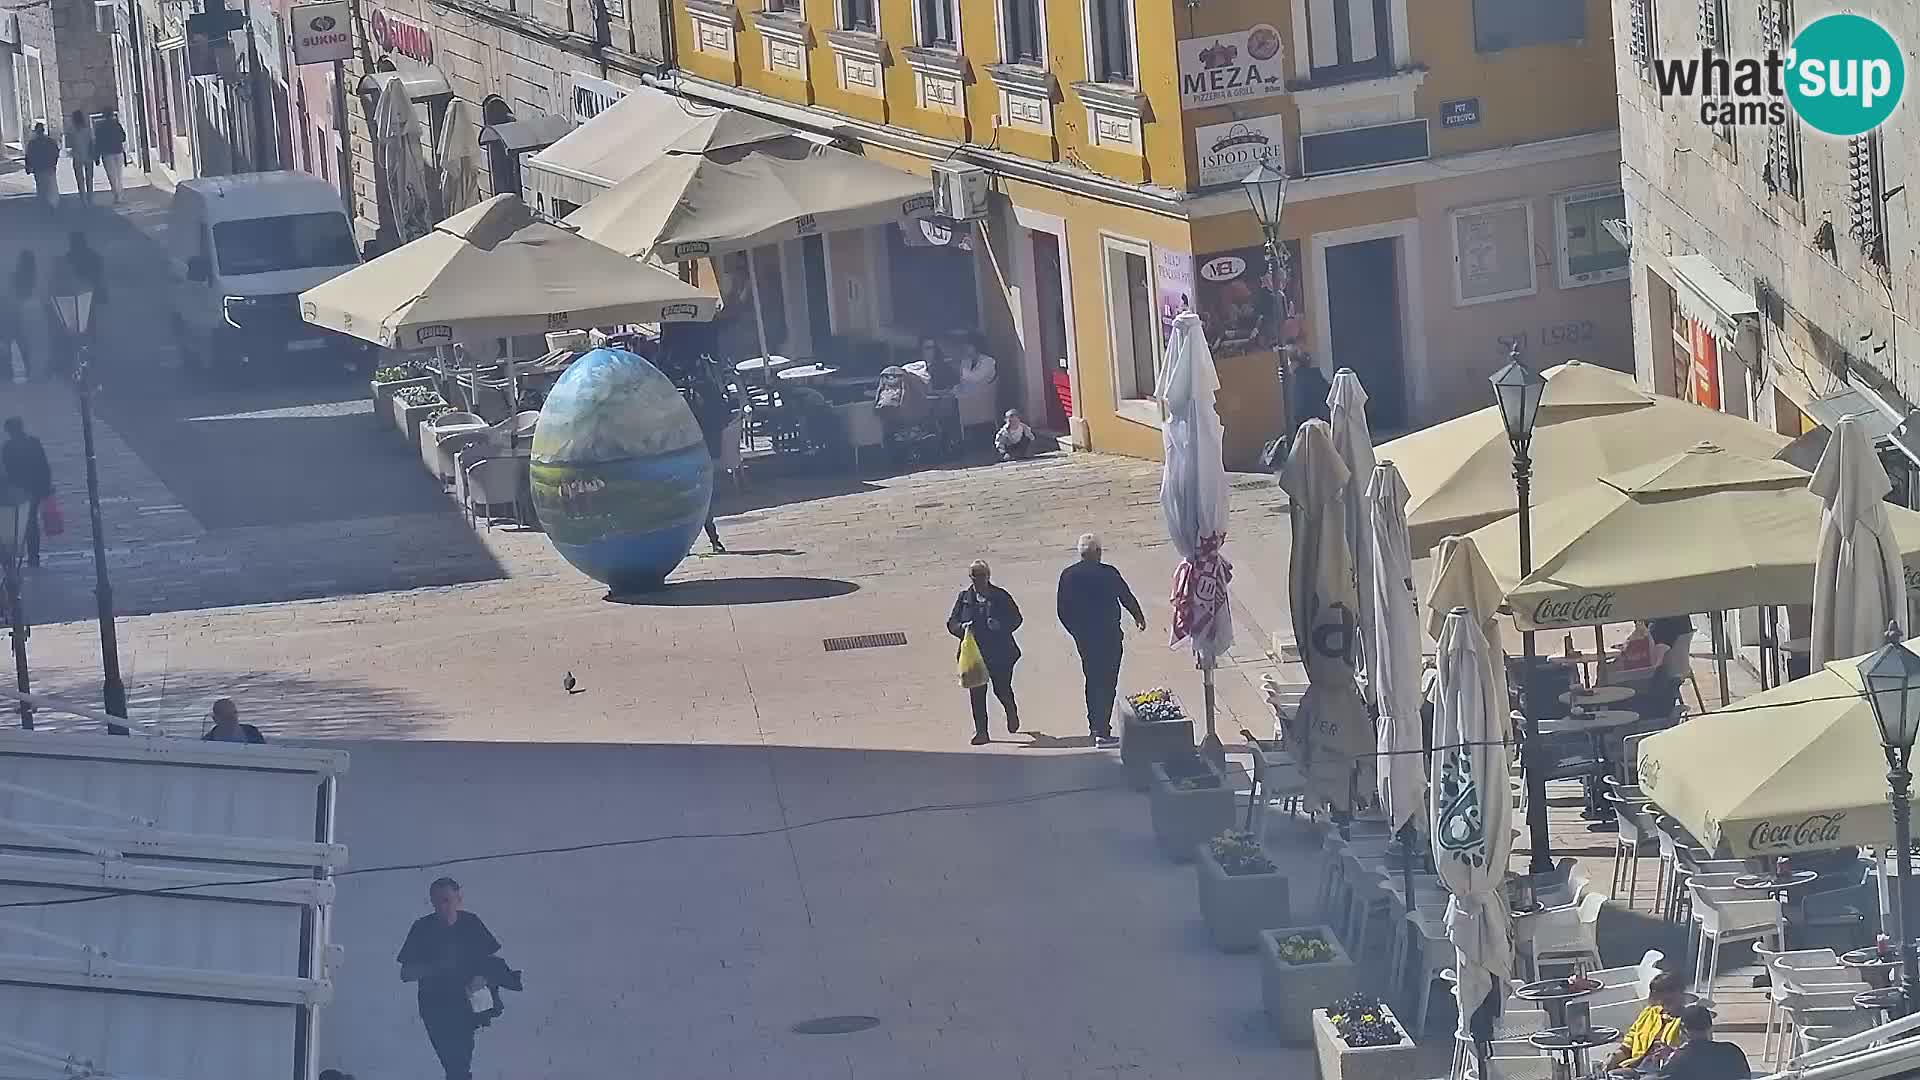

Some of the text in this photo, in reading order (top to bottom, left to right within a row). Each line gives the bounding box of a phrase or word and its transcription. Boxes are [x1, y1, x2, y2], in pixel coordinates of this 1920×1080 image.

[303, 33, 347, 47] SUKNO
[389, 18, 434, 65] SUKNO
[1184, 64, 1262, 94] MEZA
[1233, 86, 1255, 97] GRILL
[1202, 150, 1248, 168] ISPOD
[1533, 591, 1616, 624] Coca-Cola
[1748, 812, 1847, 850] Coca-Cola
